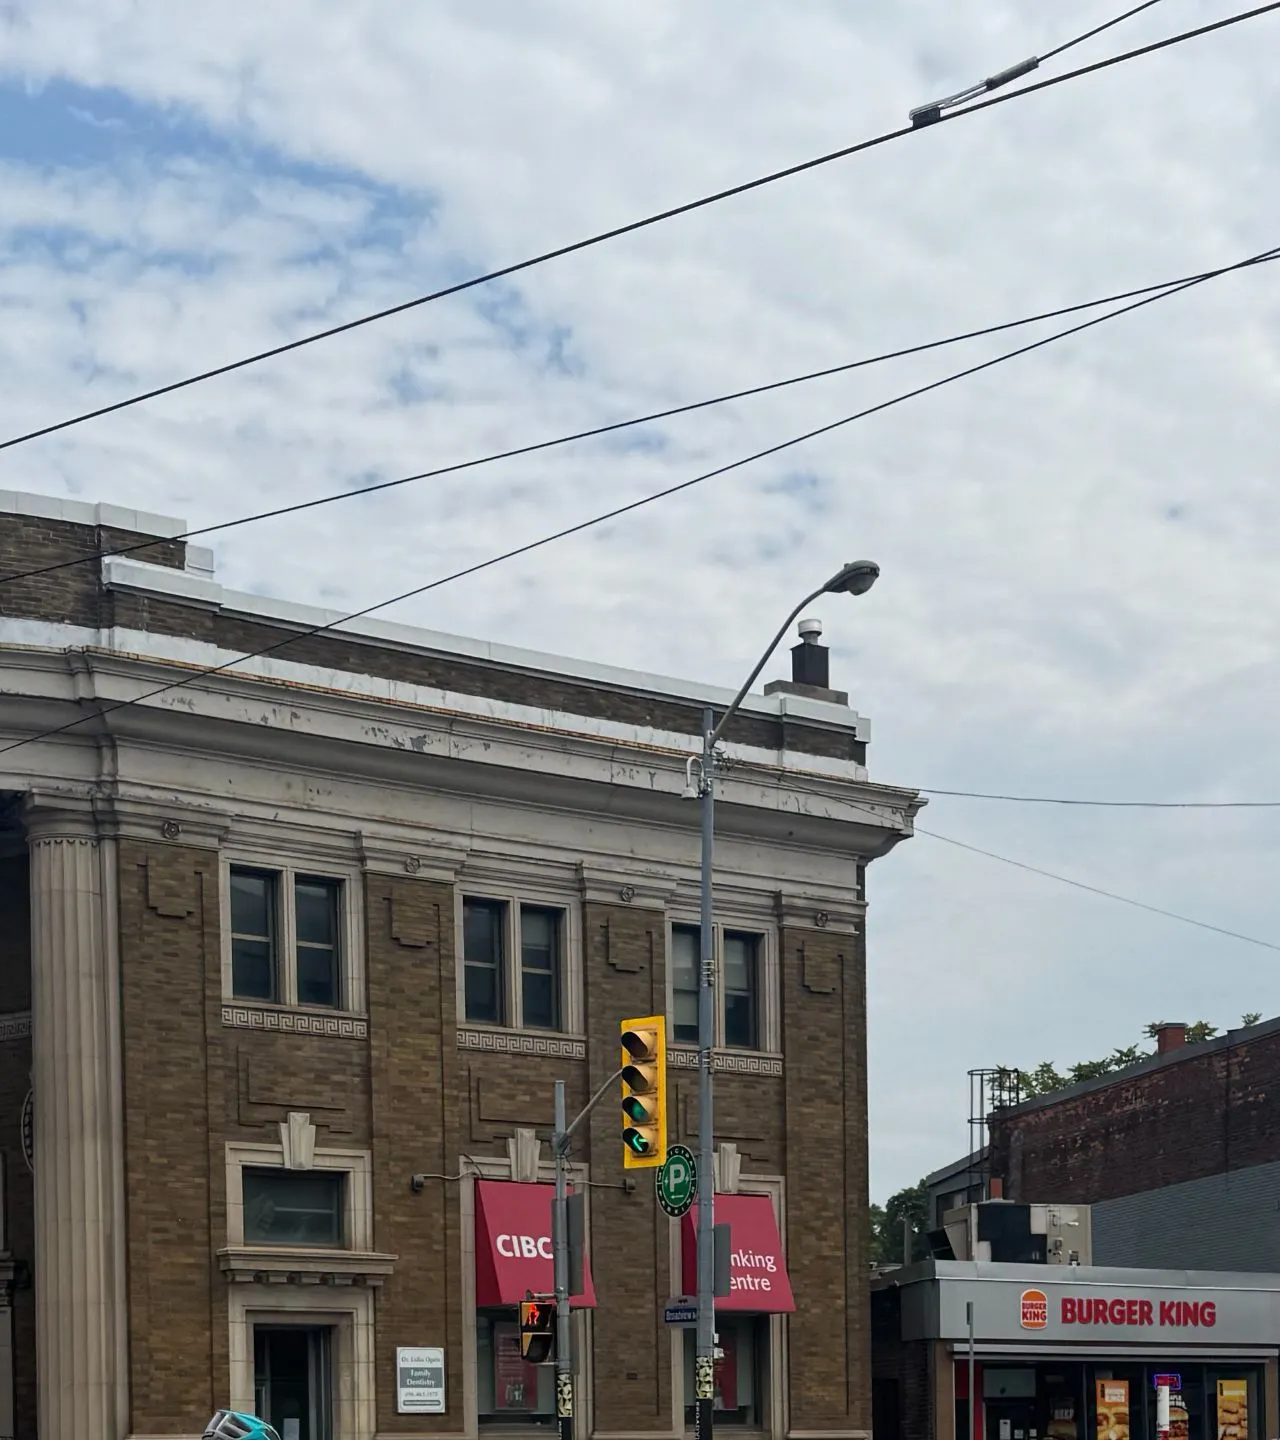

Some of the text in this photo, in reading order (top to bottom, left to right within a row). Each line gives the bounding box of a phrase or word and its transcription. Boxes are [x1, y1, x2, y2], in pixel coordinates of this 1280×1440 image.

[669, 1163, 686, 1193] P
[496, 1234, 554, 1259] CIBC
[730, 1249, 777, 1273] nking
[729, 1275, 772, 1292] entre
[1022, 1302, 1047, 1310] BURGER
[1061, 1297, 1217, 1328] BURGER KING
[1022, 1310, 1047, 1322] KING
[411, 1368, 431, 1379] Family
[407, 1378, 435, 1389] Dentistry
